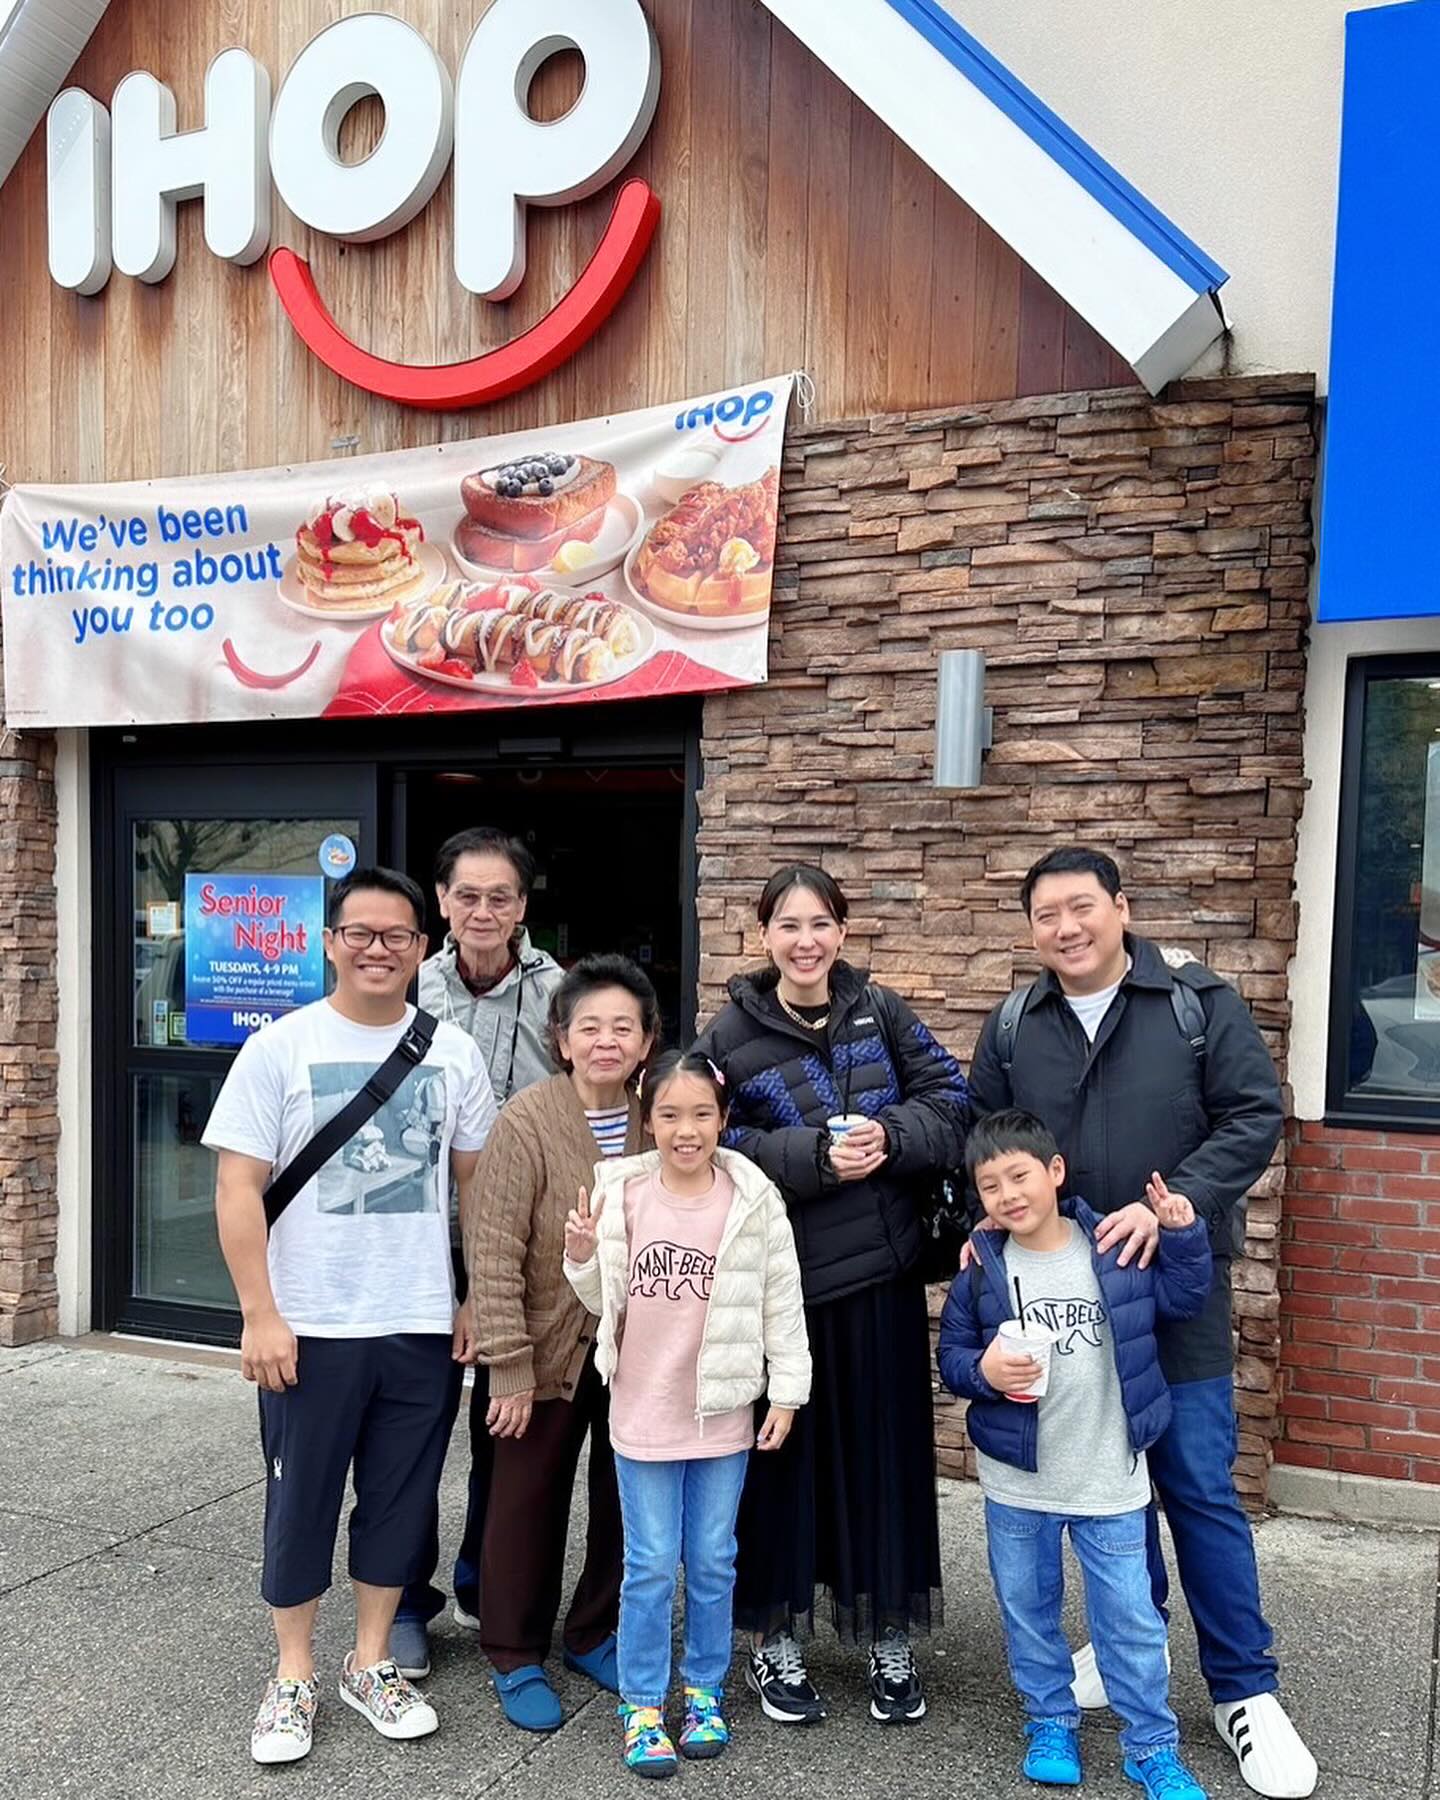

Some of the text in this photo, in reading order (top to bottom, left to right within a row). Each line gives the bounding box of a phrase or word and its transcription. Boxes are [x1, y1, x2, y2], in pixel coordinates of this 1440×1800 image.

[47, 0, 661, 300] IHOP
[675, 390, 774, 430] IHOP
[42, 504, 248, 552] We've been
[12, 543, 283, 597] thinking about
[72, 601, 215, 644] you too
[200, 883, 287, 917] Senior
[234, 919, 308, 961] Night
[209, 960, 262, 975] TUESDAYS,
[282, 964, 299, 975] PM
